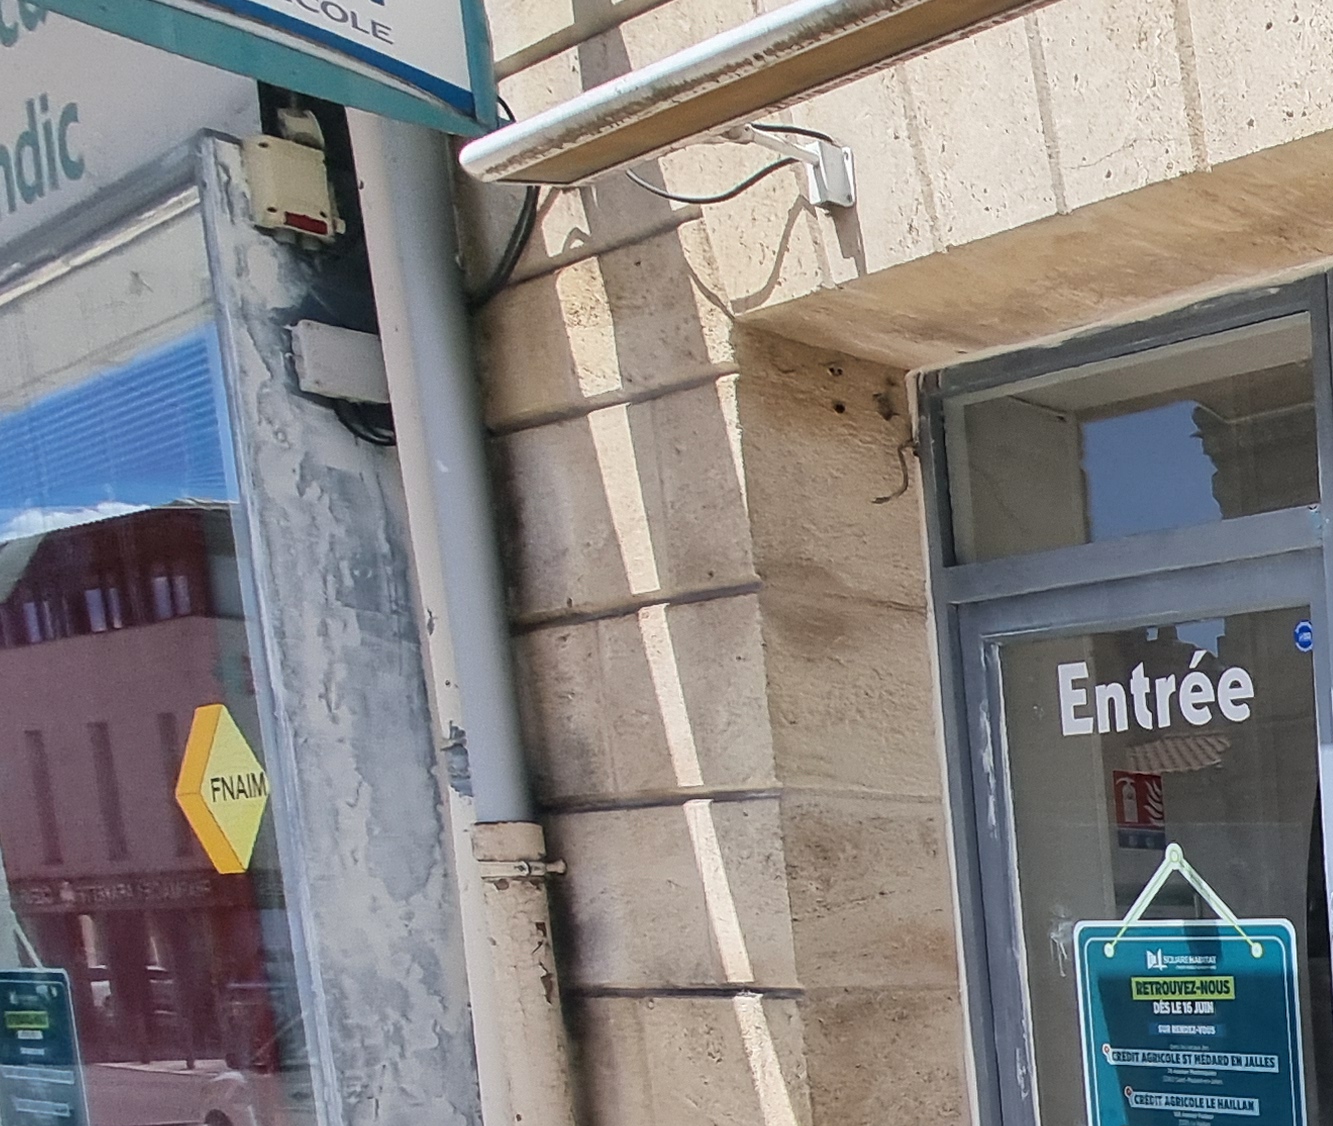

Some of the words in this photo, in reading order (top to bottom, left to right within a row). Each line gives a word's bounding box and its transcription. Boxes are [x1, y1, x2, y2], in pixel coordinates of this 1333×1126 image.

[286, 0, 394, 45] COLE
[1058, 650, 1254, 735] Entrée
[210, 771, 267, 803] FNAIM
[1135, 979, 1231, 996] RETROUVEZ-NOUS
[1171, 1001, 1182, 1014] LE
[1194, 1001, 1215, 1014] JUIN
[1141, 1052, 1181, 1064] AGRICOLE
[1182, 1054, 1192, 1065] ST
[1244, 1056, 1276, 1068] JALLES
[1164, 1095, 1204, 1108] AGRICOLE
[1206, 1097, 1216, 1109] LE
